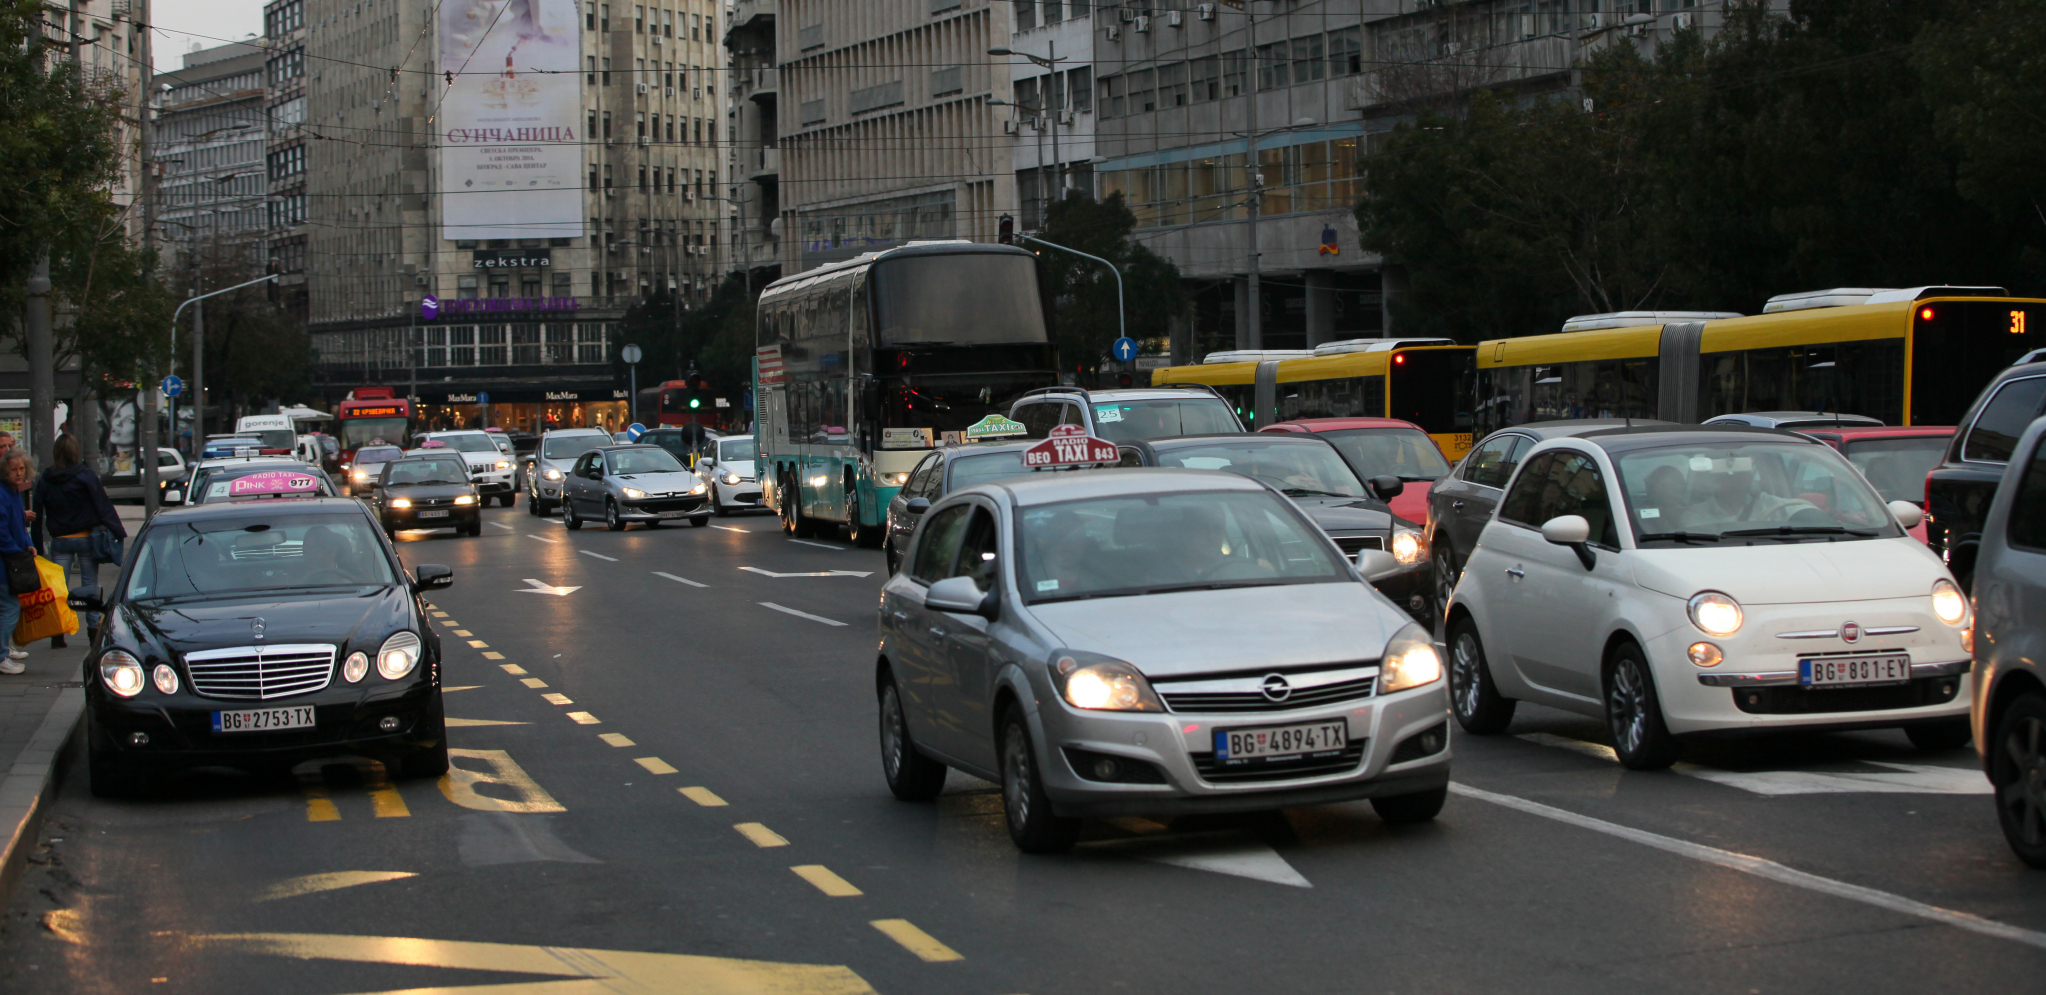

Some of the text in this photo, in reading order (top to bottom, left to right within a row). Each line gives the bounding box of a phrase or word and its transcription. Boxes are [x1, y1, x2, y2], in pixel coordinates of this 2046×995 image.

[447, 126, 575, 143] СУНЧАНИЦА
[474, 257, 550, 268] zekstra
[538, 296, 578, 311] БАНКА
[2009, 310, 2025, 333] 31
[448, 394, 477, 402] MaxMara
[546, 391, 577, 399] MaxMara
[1100, 410, 1118, 419] 25
[245, 420, 284, 428] gorenje
[984, 423, 1010, 432] TAXI
[1053, 438, 1089, 446] RADIO
[1028, 444, 1114, 464] BEO TAXI 843
[252, 472, 276, 480] RADIO
[290, 479, 311, 487] 977
[215, 486, 226, 494] 4
[25, 609, 44, 622] kids
[1814, 663, 1835, 681] BG
[223, 713, 242, 729] BG
[1231, 733, 1255, 755] BG
